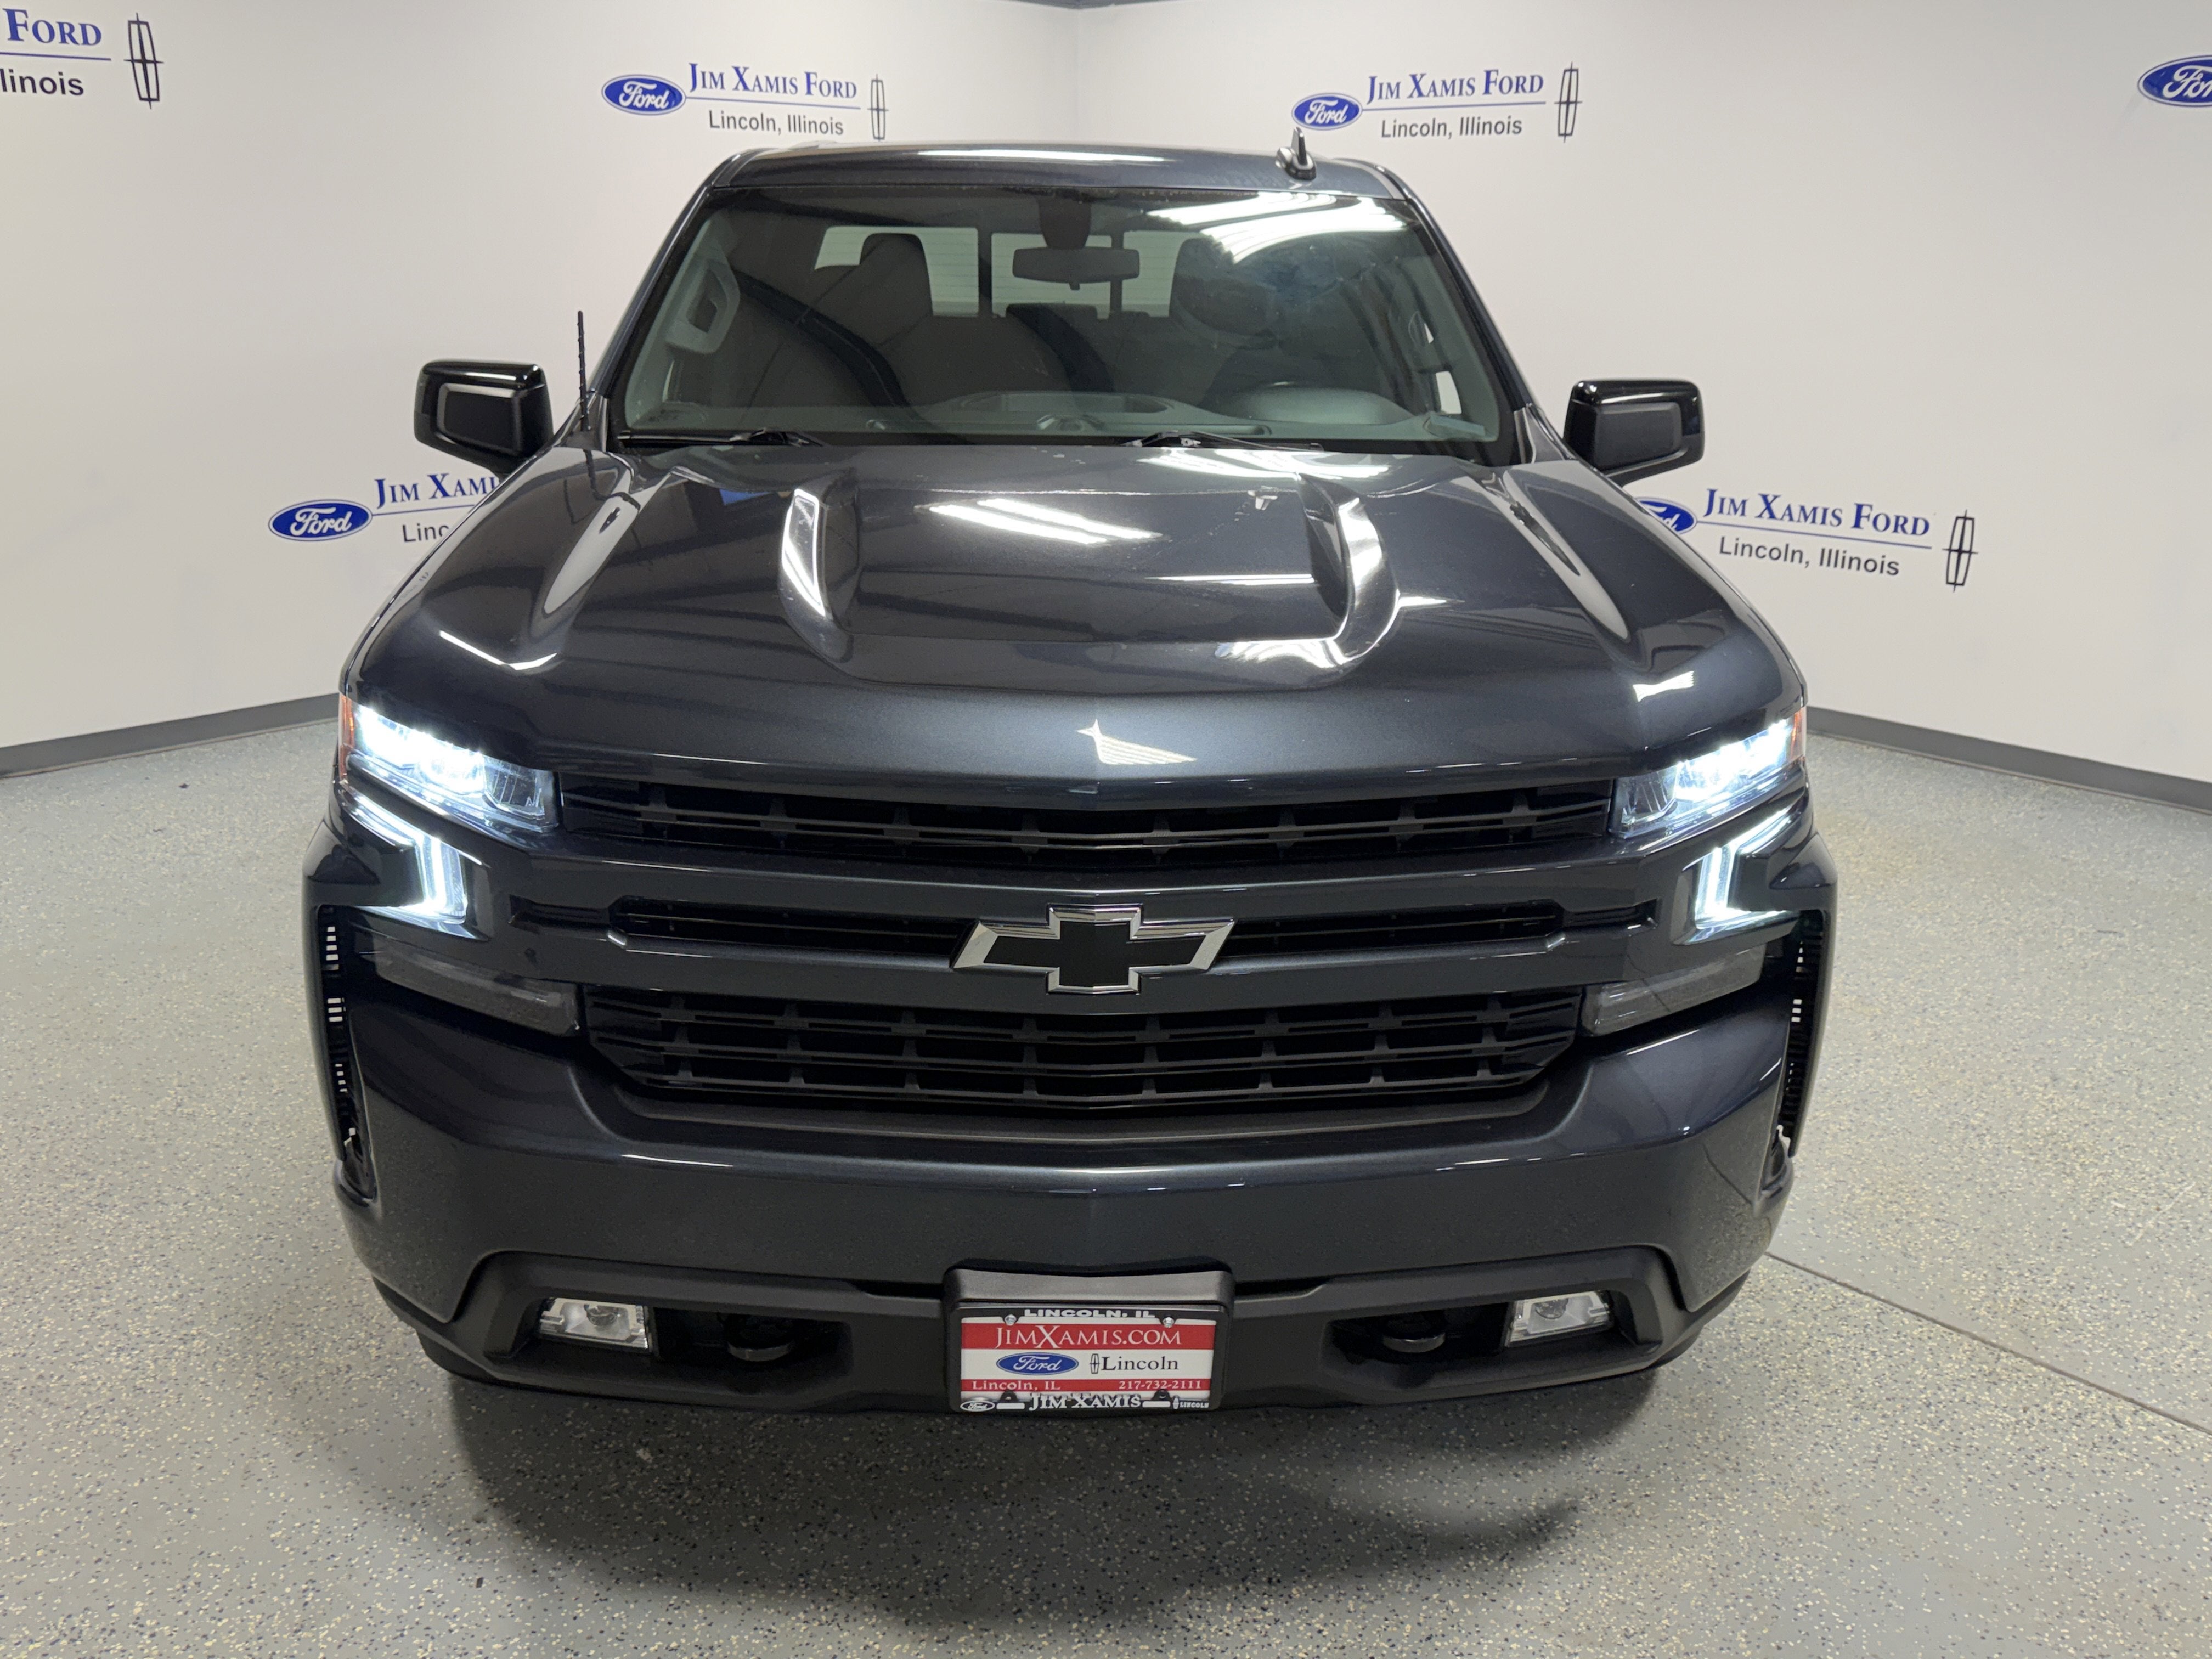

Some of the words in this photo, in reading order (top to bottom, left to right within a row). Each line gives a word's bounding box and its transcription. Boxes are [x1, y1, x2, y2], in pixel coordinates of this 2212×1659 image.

[2, 8, 102, 46] FORD
[0, 69, 84, 96] linois
[688, 63, 725, 93] JIM
[731, 66, 799, 95] XAMIS
[804, 71, 857, 98] FORD
[1366, 76, 1401, 105] JIM
[1407, 73, 1476, 99] XAMIS
[1482, 69, 1544, 95] FORD
[2162, 65, 2212, 99] For
[618, 80, 670, 109] Ford
[709, 110, 781, 136] Lincoln,
[787, 114, 844, 136] Illinois
[1304, 99, 1350, 124] Ford
[1381, 117, 1453, 139] Lincoln,
[1458, 115, 1522, 136] Illinois
[374, 478, 420, 510] JIM
[426, 473, 496, 500] XAMI
[290, 507, 353, 536] Ford
[1703, 488, 1748, 517] JIM
[1754, 493, 1843, 528] XAMIS
[1851, 503, 1931, 537] FORD
[402, 522, 450, 543] Linc
[1719, 536, 1810, 569] Lincoln,
[1819, 548, 1900, 577] Illinois
[1135, 1310, 1155, 1318] IL
[995, 1325, 1182, 1349] JIMXAMIS.COM
[1013, 1355, 1062, 1371] Ford
[1101, 1356, 1179, 1371] Lincoln
[1045, 1381, 1060, 1390] IL
[1119, 1380, 1201, 1390] 217-732-2111
[1029, 1393, 1067, 1411] JIM
[1071, 1393, 1141, 1409] XAMIS
